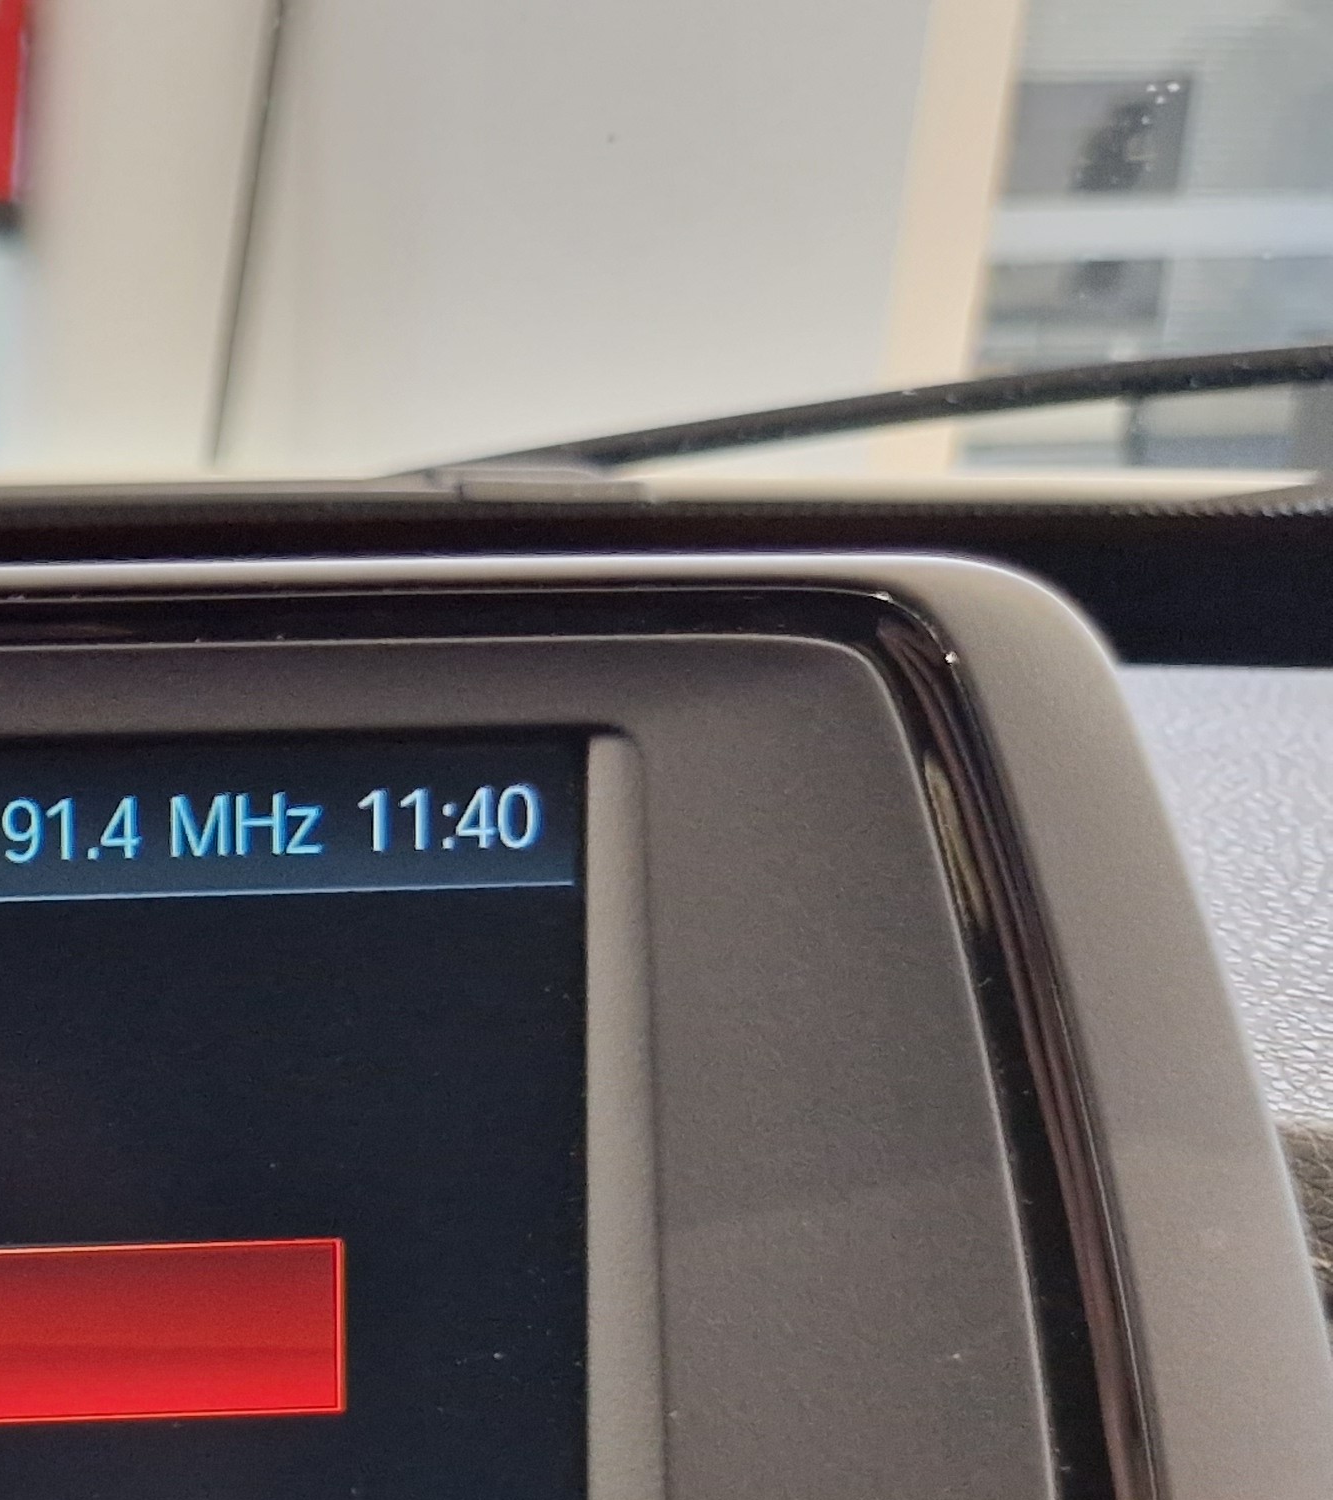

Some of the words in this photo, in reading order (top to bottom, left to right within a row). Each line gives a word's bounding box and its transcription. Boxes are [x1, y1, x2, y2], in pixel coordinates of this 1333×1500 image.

[1, 795, 142, 864] 91.4
[169, 791, 323, 858] MHz
[357, 783, 540, 853] 11:40
